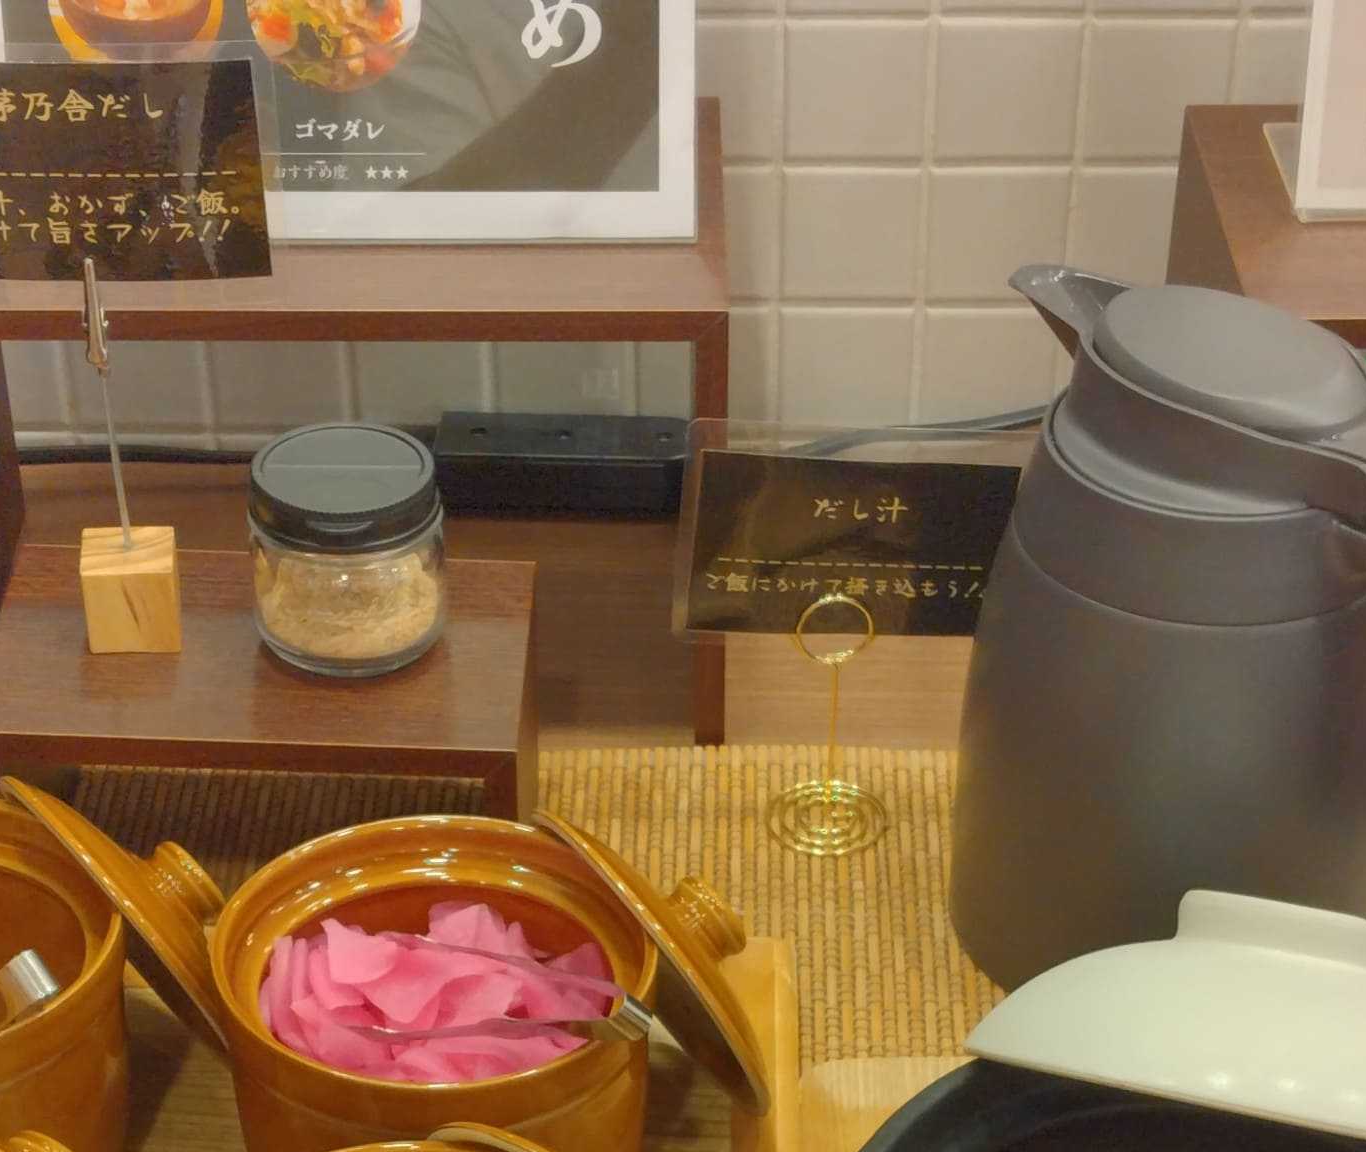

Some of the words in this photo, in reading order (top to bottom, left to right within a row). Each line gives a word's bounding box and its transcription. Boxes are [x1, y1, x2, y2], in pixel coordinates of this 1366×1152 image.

[295, 117, 386, 142] ゴマダレ
[813, 497, 909, 524] だし汁
